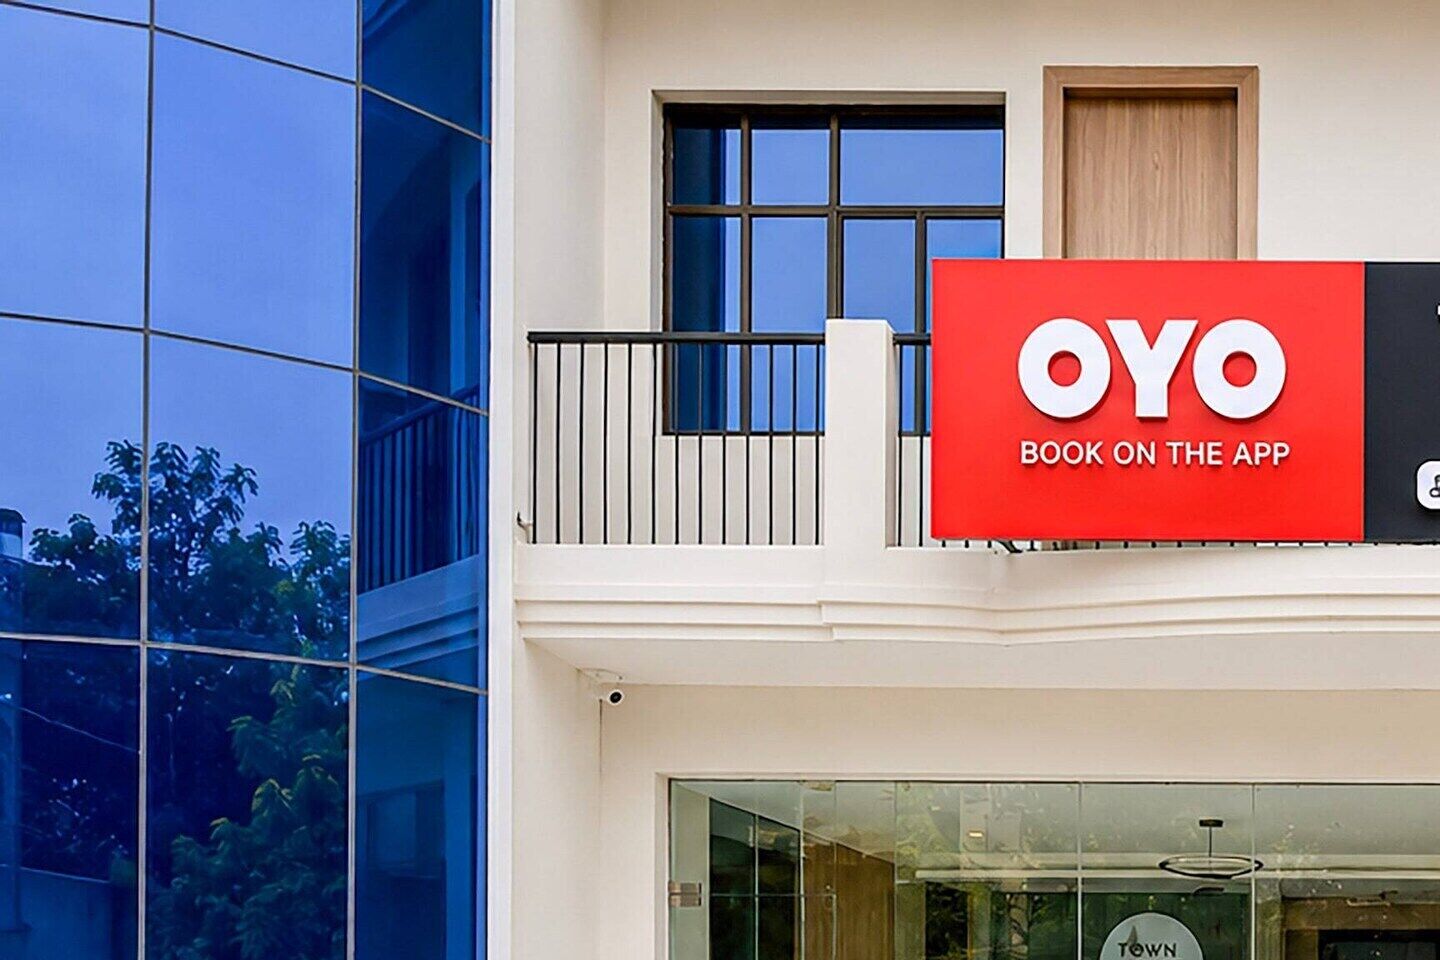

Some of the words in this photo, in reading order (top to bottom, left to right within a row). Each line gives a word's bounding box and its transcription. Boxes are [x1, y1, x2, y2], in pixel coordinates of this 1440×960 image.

[1018, 318, 1286, 419] OYO
[1020, 440, 1104, 465] BOOK
[1112, 441, 1156, 466] ON
[1165, 441, 1223, 466] THE
[1232, 442, 1290, 466] APP
[1118, 942, 1177, 957] TOWN
